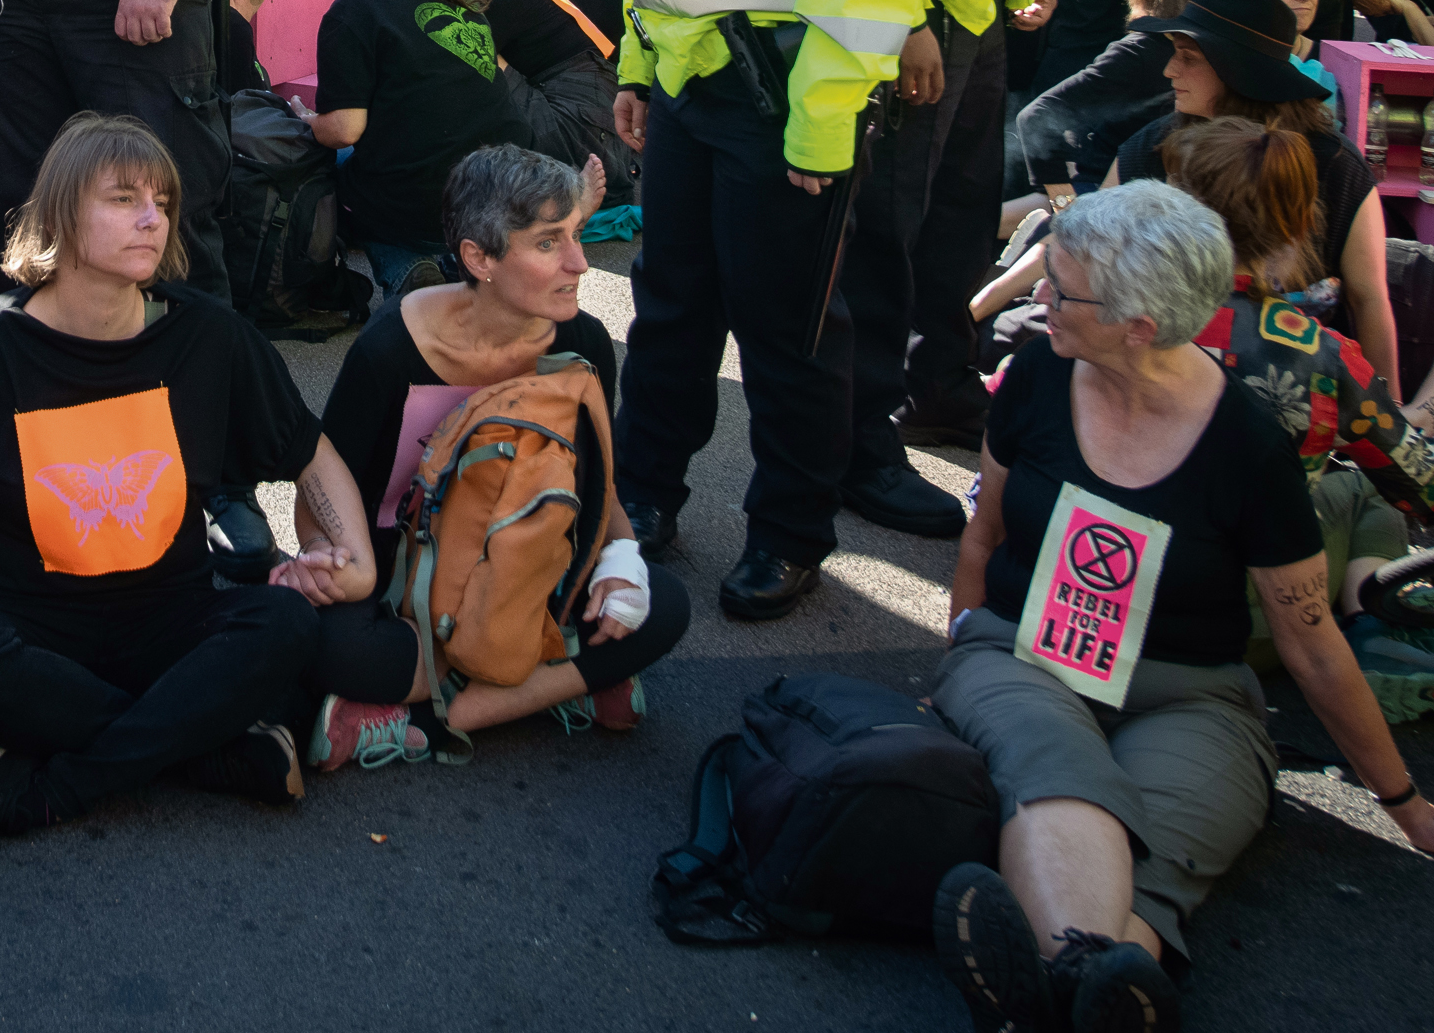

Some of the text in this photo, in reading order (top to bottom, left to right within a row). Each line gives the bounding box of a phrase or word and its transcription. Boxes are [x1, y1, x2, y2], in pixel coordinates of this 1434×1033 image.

[1054, 581, 1122, 624] REBEL
[1066, 610, 1102, 635] FOR
[1037, 617, 1117, 675] LIFE
